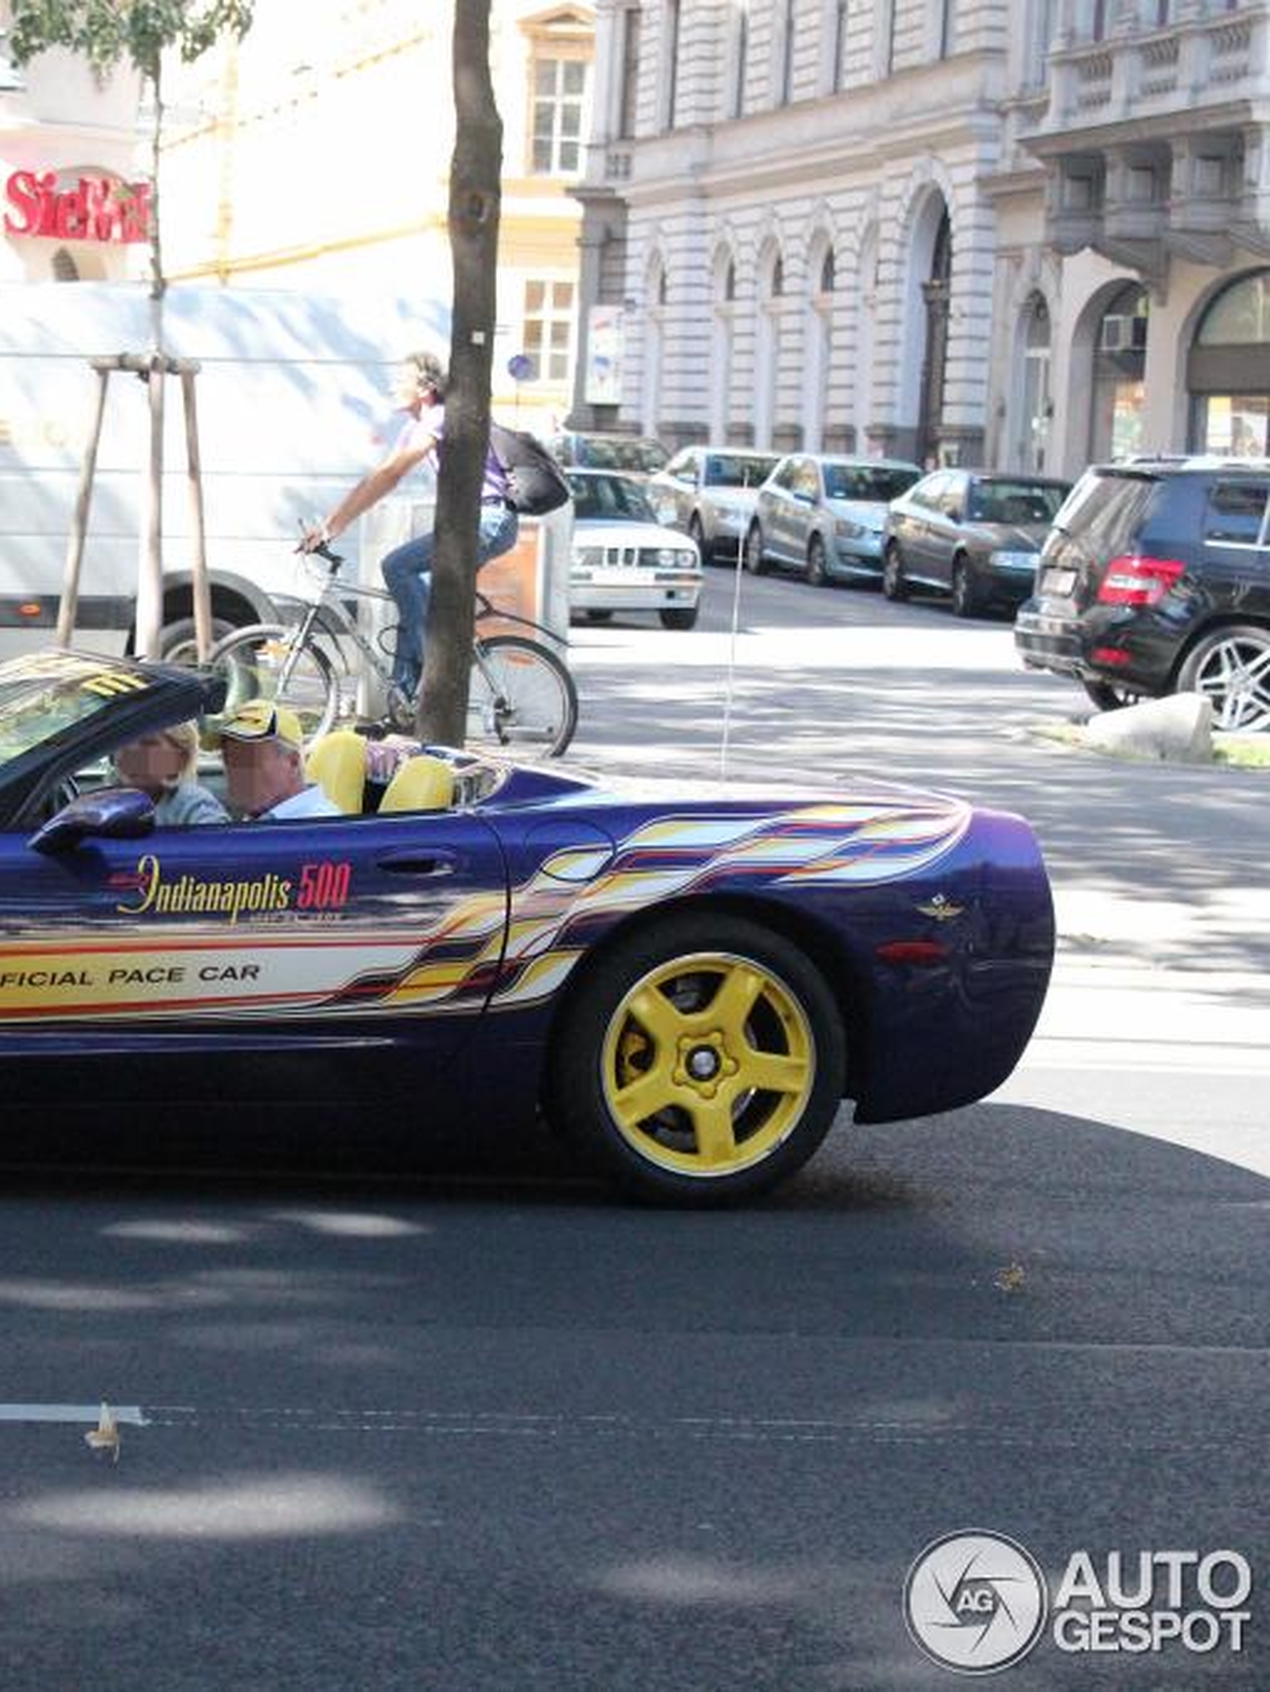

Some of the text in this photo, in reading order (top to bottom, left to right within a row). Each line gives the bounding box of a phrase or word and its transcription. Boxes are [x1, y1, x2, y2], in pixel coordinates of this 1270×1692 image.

[117, 855, 351, 926] Indianapolis 500
[108, 967, 185, 984] PACE
[198, 965, 260, 981] CAR
